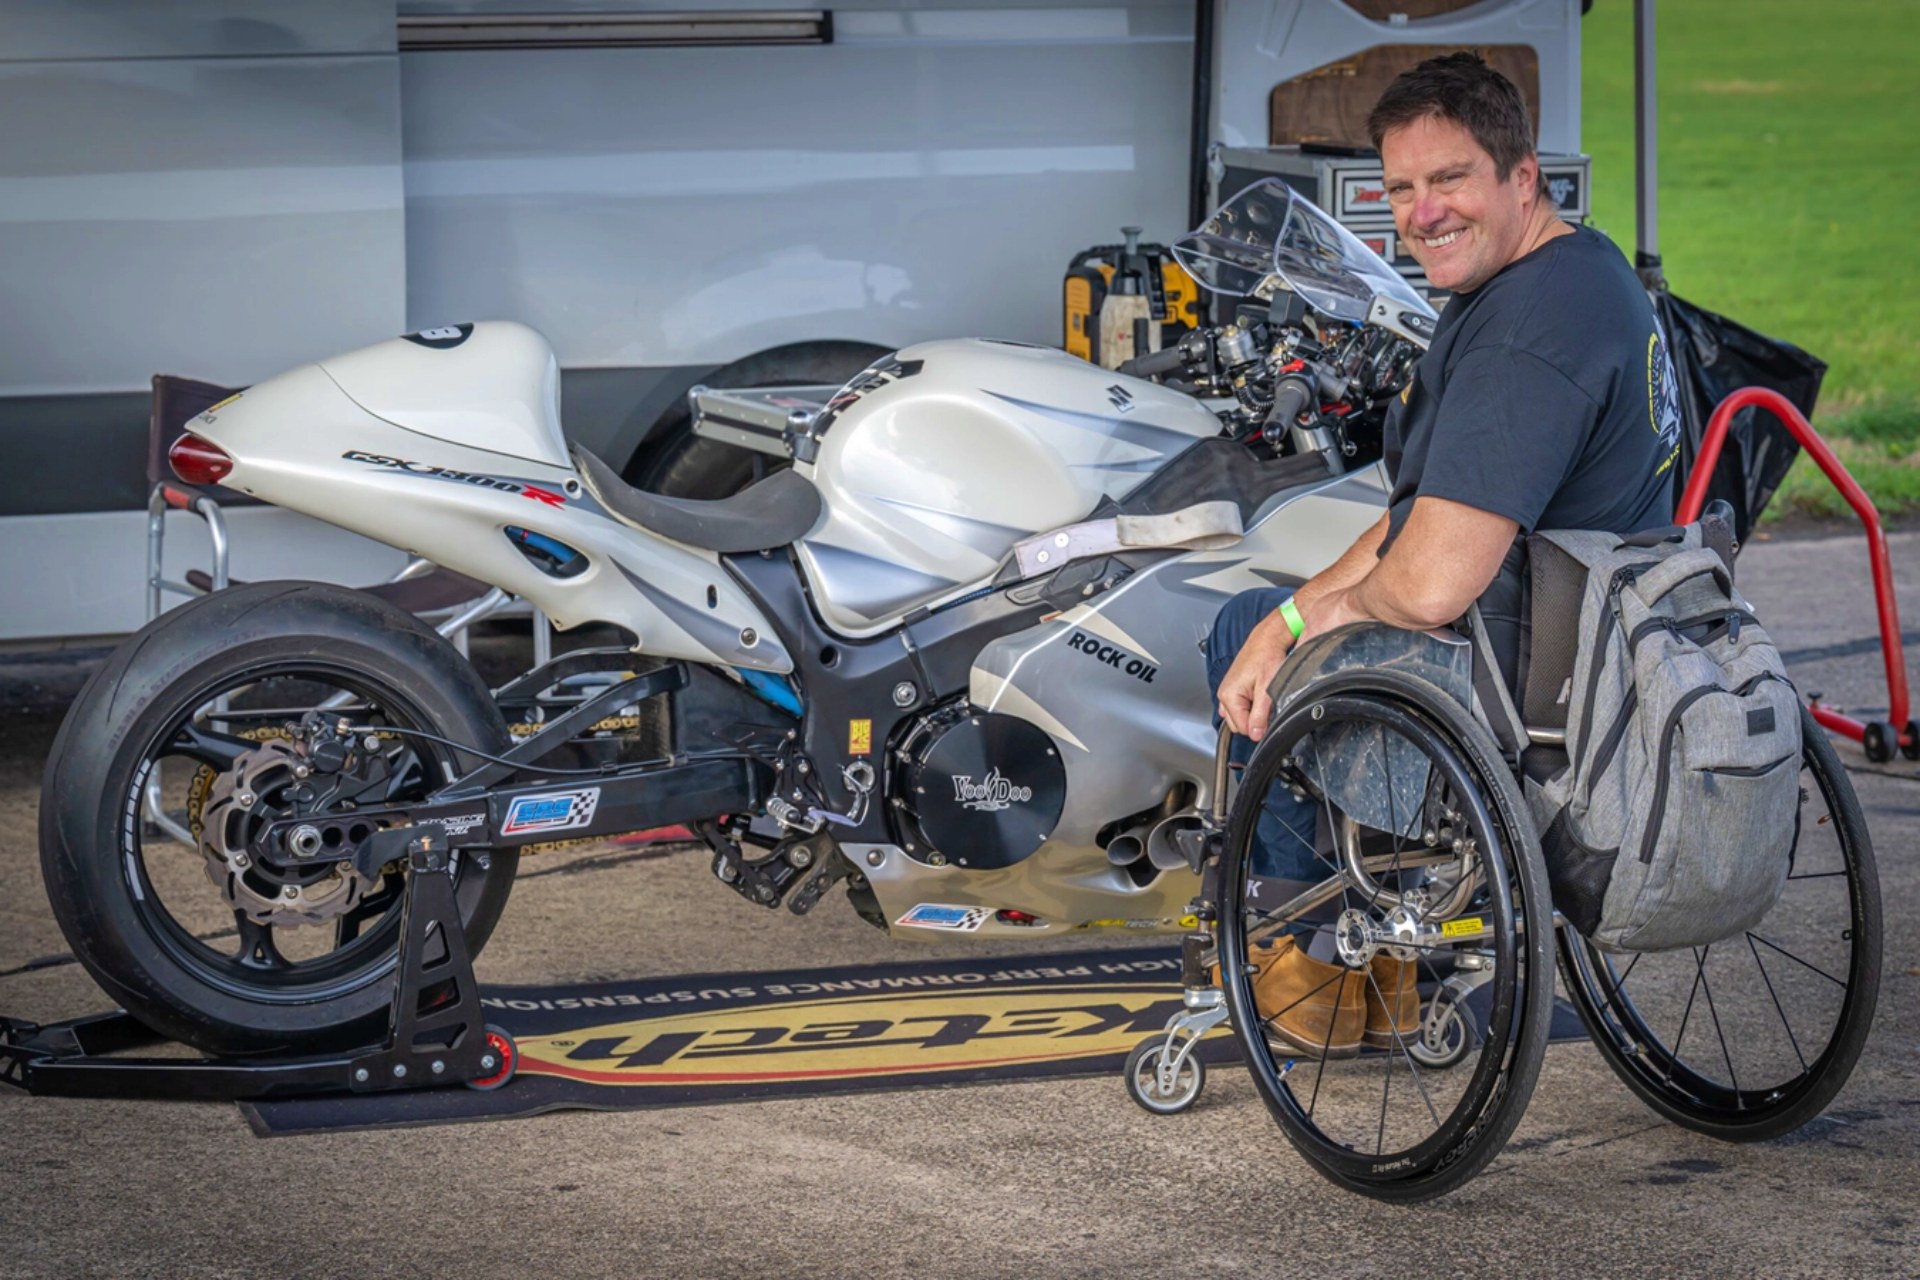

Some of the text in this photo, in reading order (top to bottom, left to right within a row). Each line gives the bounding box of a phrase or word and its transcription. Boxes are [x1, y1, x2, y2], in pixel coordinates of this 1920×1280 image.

[1067, 632, 1158, 684] ROCK OIL
[514, 798, 574, 823] SPS
[764, 965, 1092, 995] PERFORMANCE
